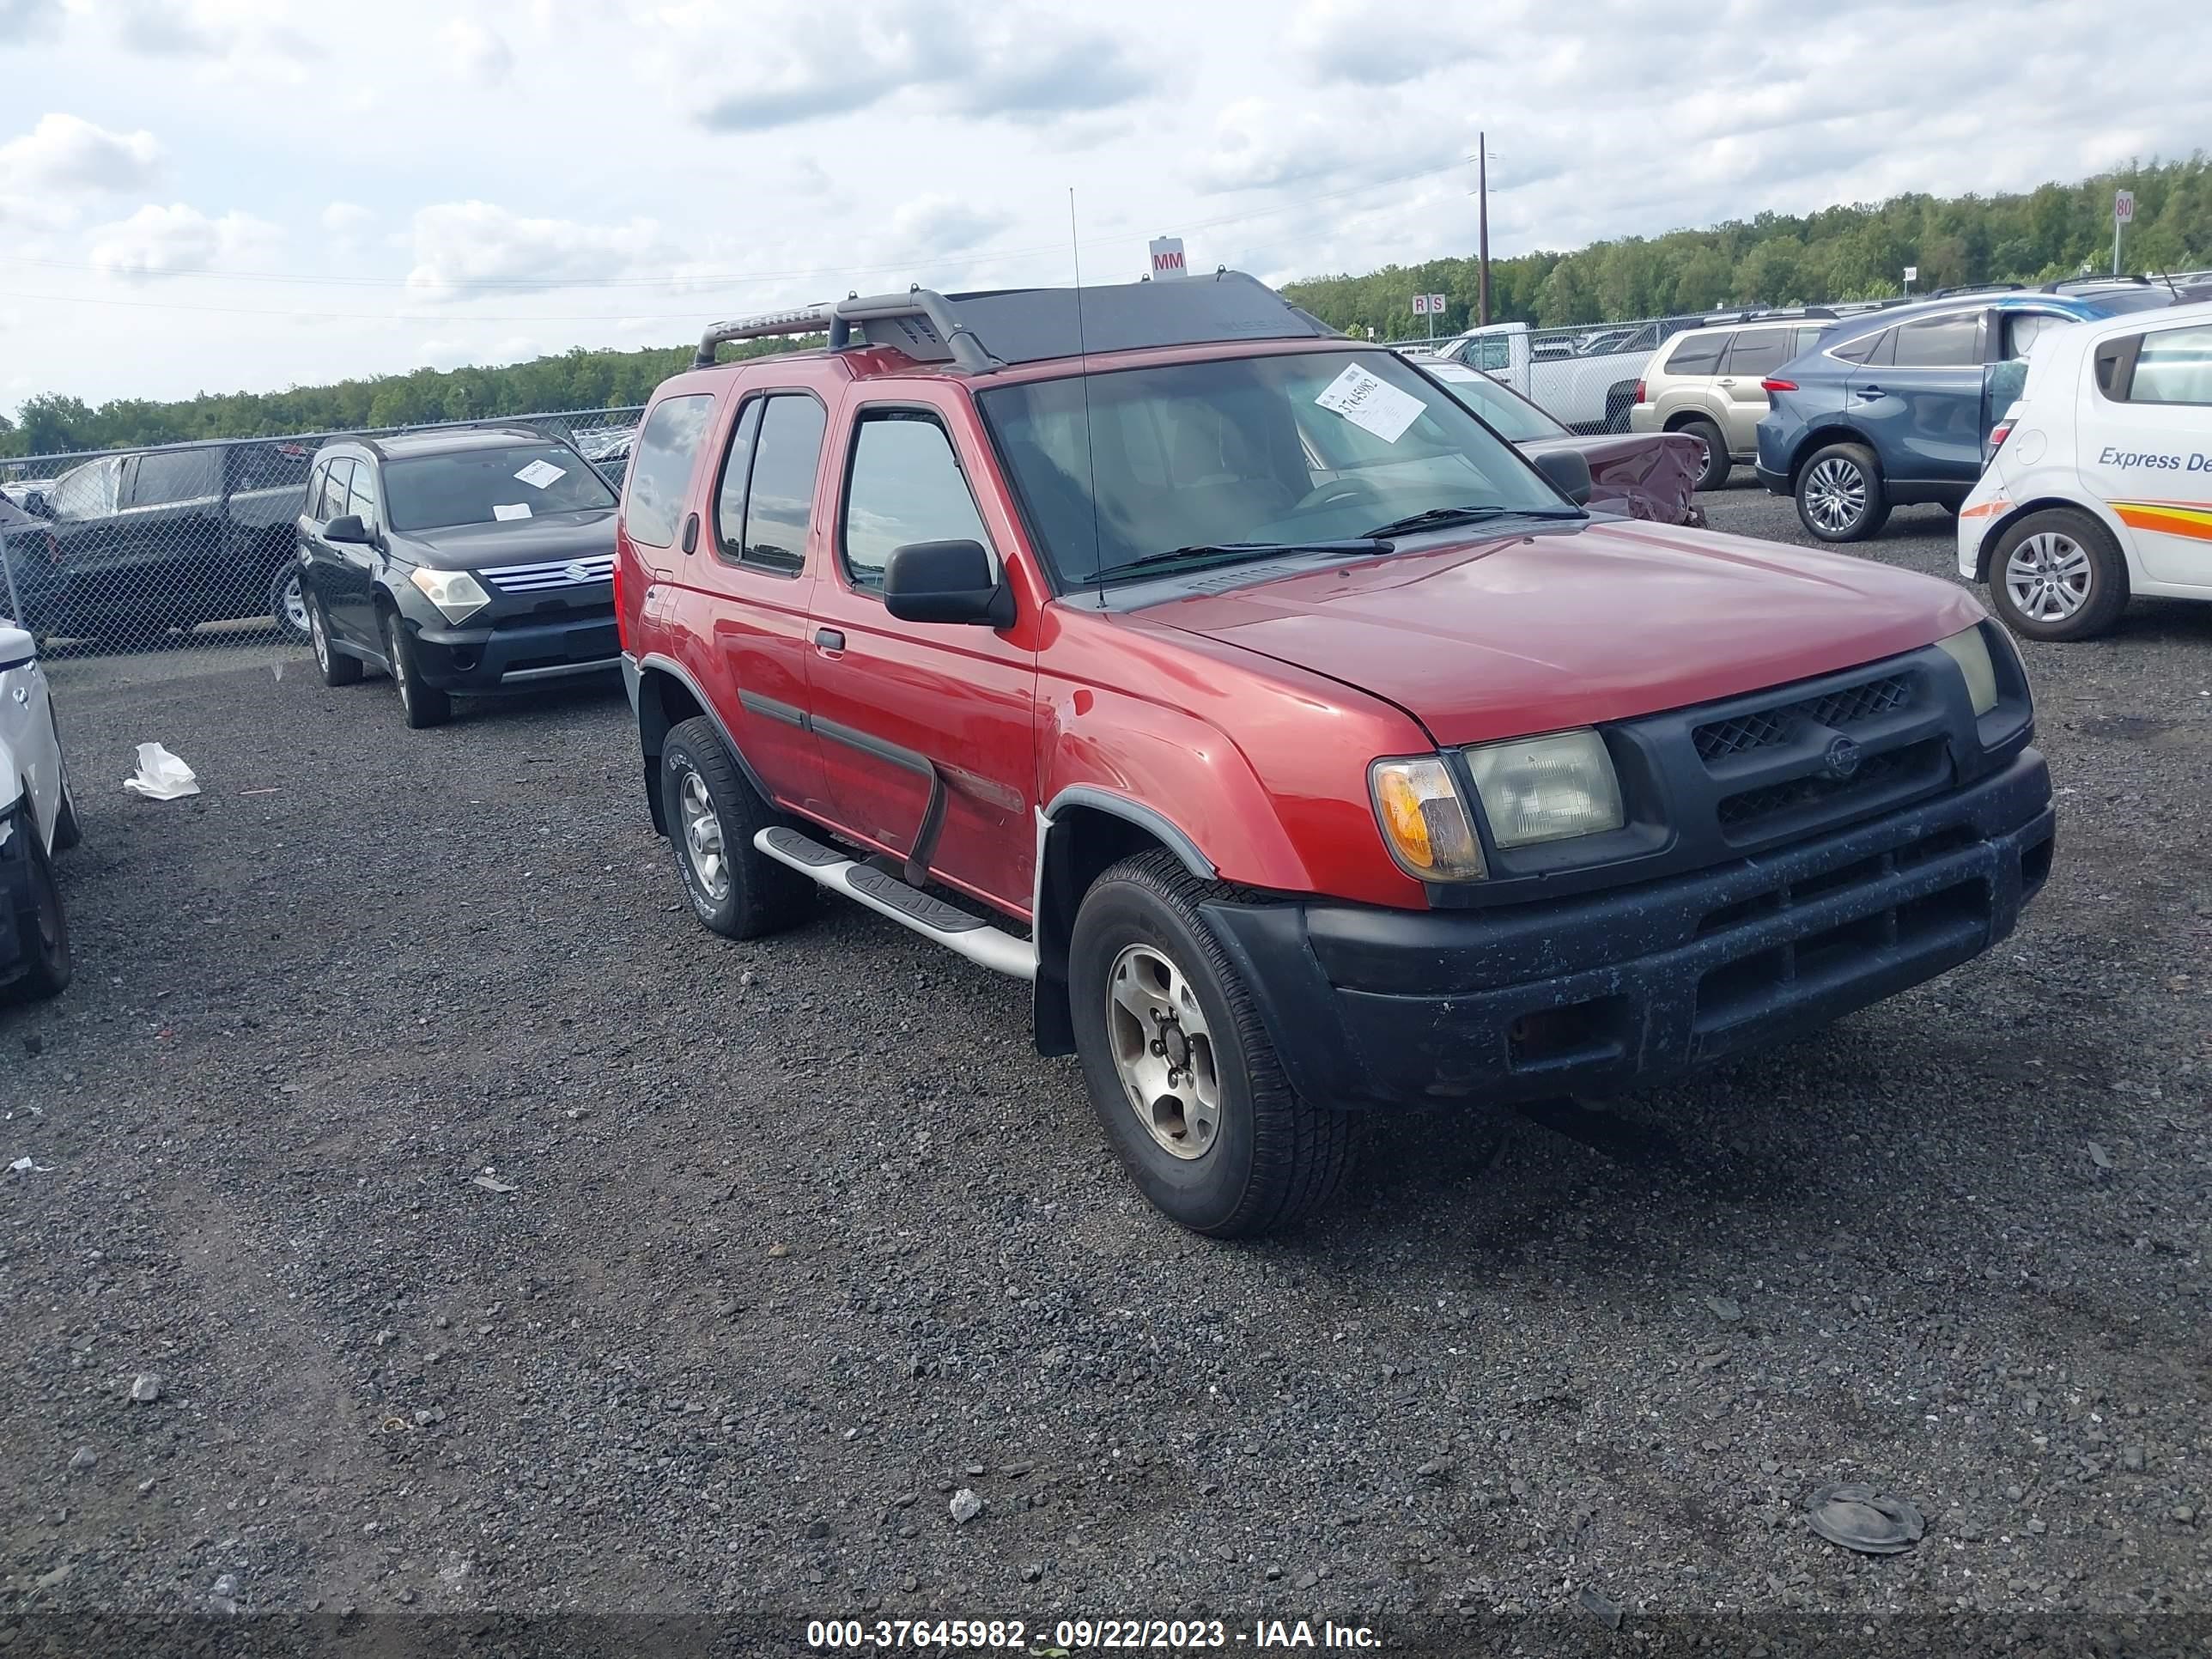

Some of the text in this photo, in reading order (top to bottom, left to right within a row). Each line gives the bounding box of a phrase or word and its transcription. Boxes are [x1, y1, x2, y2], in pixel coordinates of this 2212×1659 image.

[2117, 198, 2131, 216] 80
[1153, 252, 1184, 270] MM
[1415, 299, 1425, 312] R
[1433, 297, 1443, 310] S
[714, 309, 817, 336] XTERRA
[1337, 377, 1379, 414] 37645982
[2098, 446, 2212, 473] Express De
